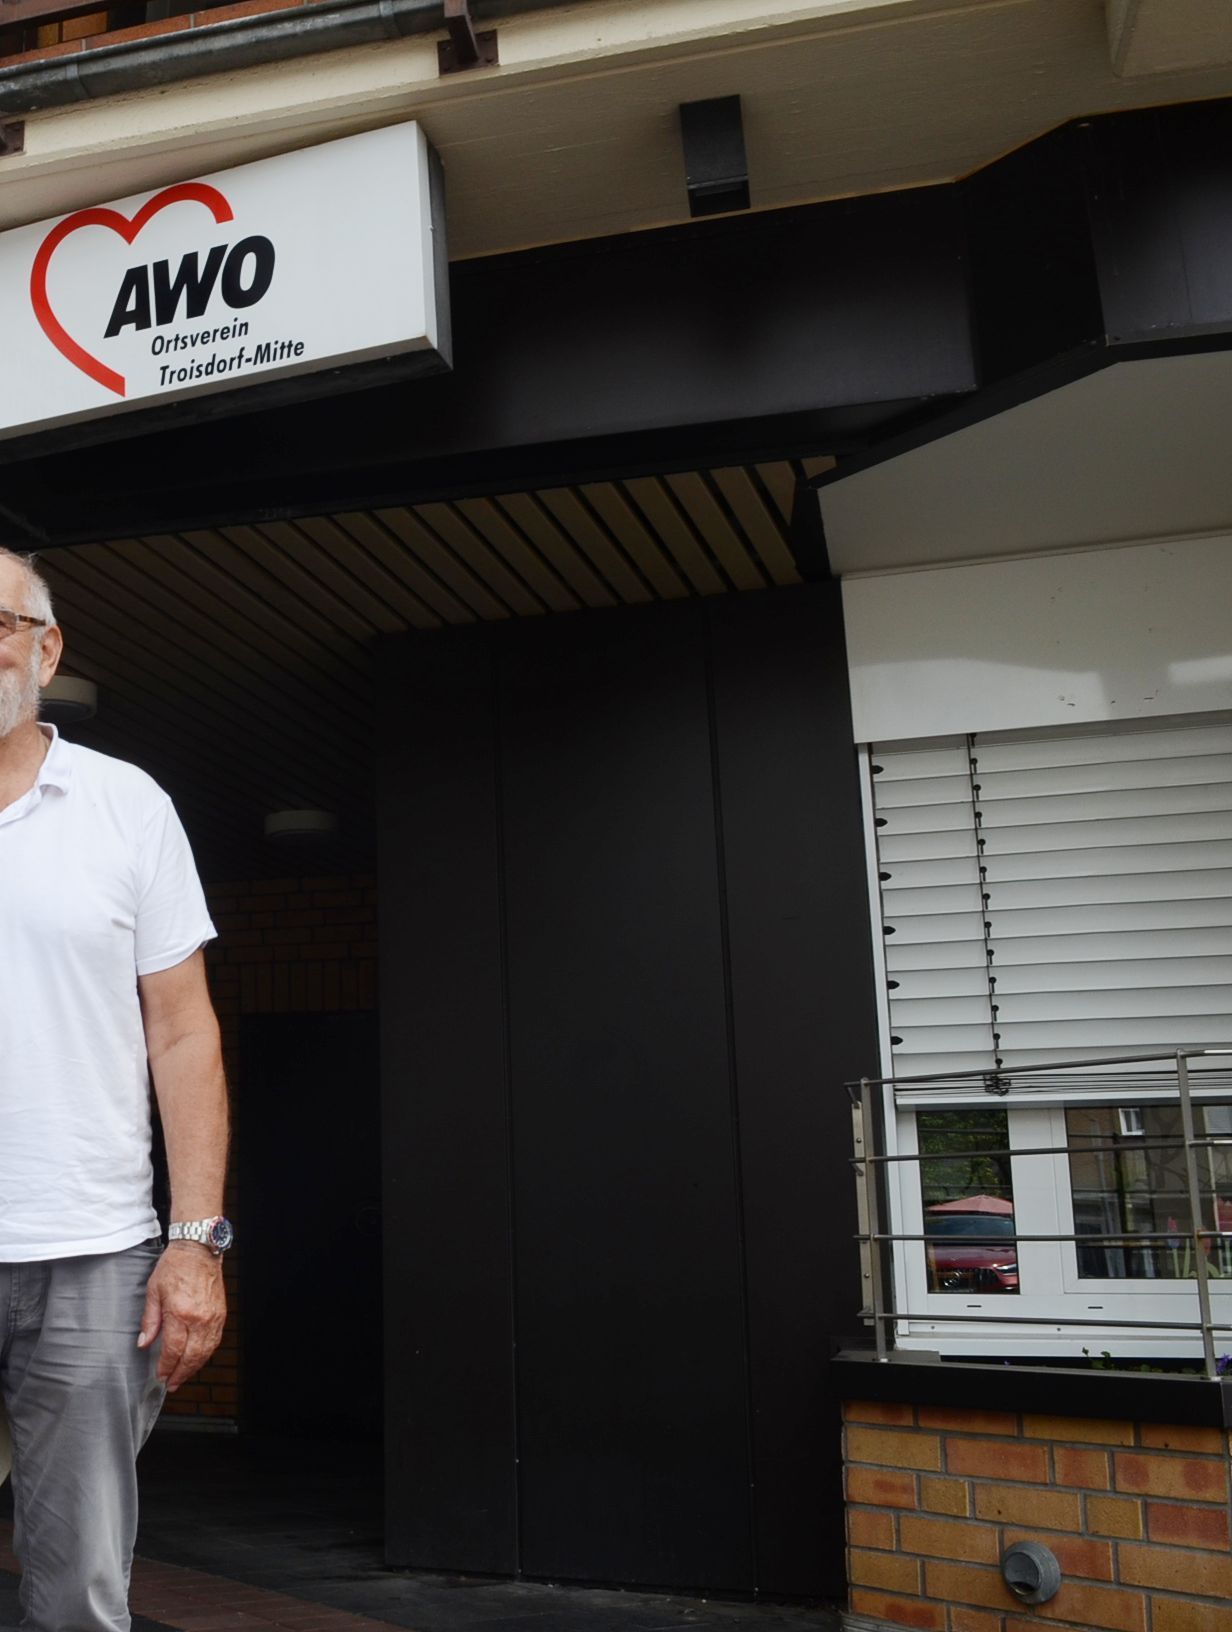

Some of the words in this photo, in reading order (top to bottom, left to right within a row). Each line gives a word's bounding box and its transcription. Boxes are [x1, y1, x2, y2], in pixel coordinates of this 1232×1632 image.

[103, 235, 275, 338] AWO
[151, 318, 249, 356] Ortsverein
[159, 339, 305, 386] Troisdorf-Mitte
